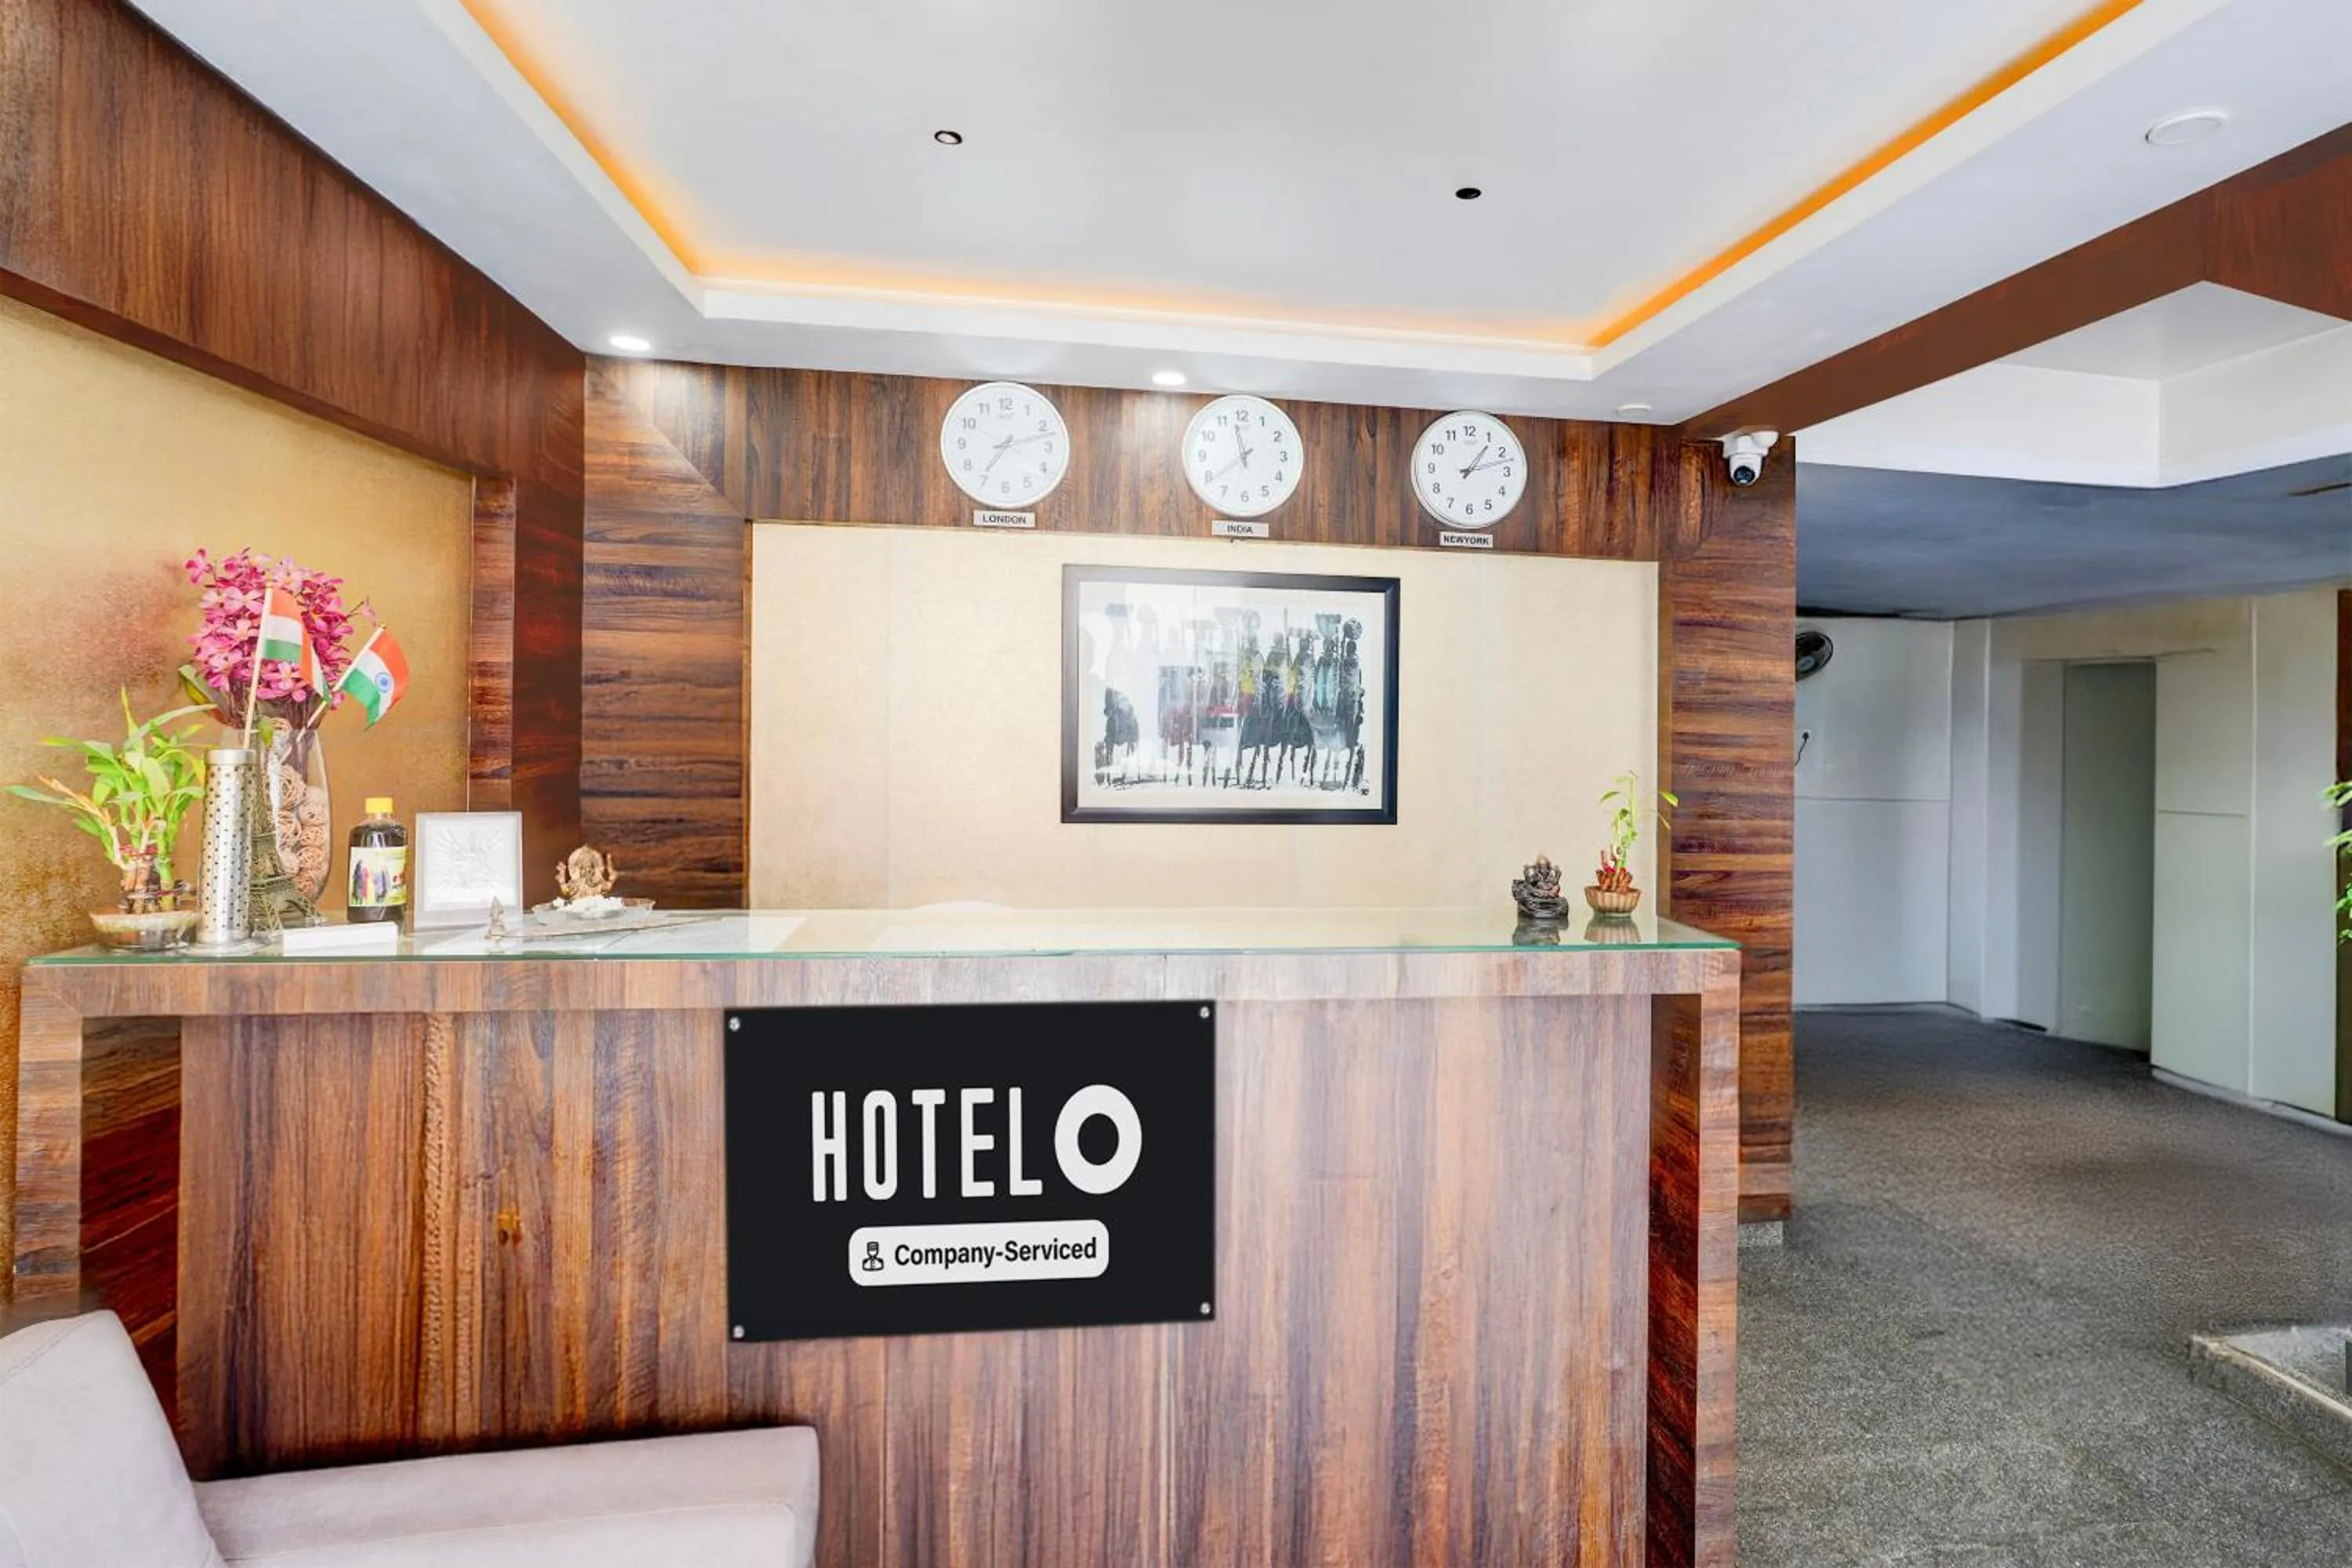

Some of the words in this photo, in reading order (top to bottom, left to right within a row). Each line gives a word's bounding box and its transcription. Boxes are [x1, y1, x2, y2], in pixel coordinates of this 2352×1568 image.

[978, 403, 990, 414] 11
[998, 398, 1013, 409] 12
[1025, 405, 1029, 416] 1
[1236, 411, 1249, 421] 12
[962, 418, 976, 429] 10
[1038, 420, 1047, 431] 2
[1217, 416, 1228, 426] 11
[1260, 416, 1265, 426] 1
[1202, 430, 1214, 441] 10
[1273, 431, 1282, 442] 2
[1446, 430, 1456, 441] 11
[1464, 426, 1475, 436] 12
[1486, 432, 1490, 442] 1
[957, 438, 966, 449] 9
[1044, 441, 1052, 452] 3
[1432, 444, 1444, 455] 10
[1499, 447, 1506, 458] 2
[1199, 451, 1207, 461] 9
[1279, 452, 1287, 463] 3
[964, 459, 971, 470] 8
[1040, 463, 1047, 474] 4
[1428, 463, 1436, 474] 9
[1275, 471, 1282, 481] 4
[1504, 467, 1511, 477] 3
[980, 476, 988, 486] 7
[1023, 477, 1031, 488] 5
[1001, 482, 1010, 493] 6
[1221, 486, 1228, 496] 7
[1261, 486, 1269, 496] 5
[1432, 483, 1440, 493] 8
[1498, 487, 1505, 496] 4
[1241, 492, 1249, 502] 6
[1447, 498, 1454, 508] 7
[1465, 503, 1473, 514] 6
[1485, 499, 1491, 510] 5
[982, 514, 1026, 524] LONDON
[1443, 535, 1489, 545] NEWYORK
[811, 1087, 1043, 1202] HOTEL
[1054, 1084, 1142, 1194] O
[895, 1237, 1098, 1269] Company-Serviced
